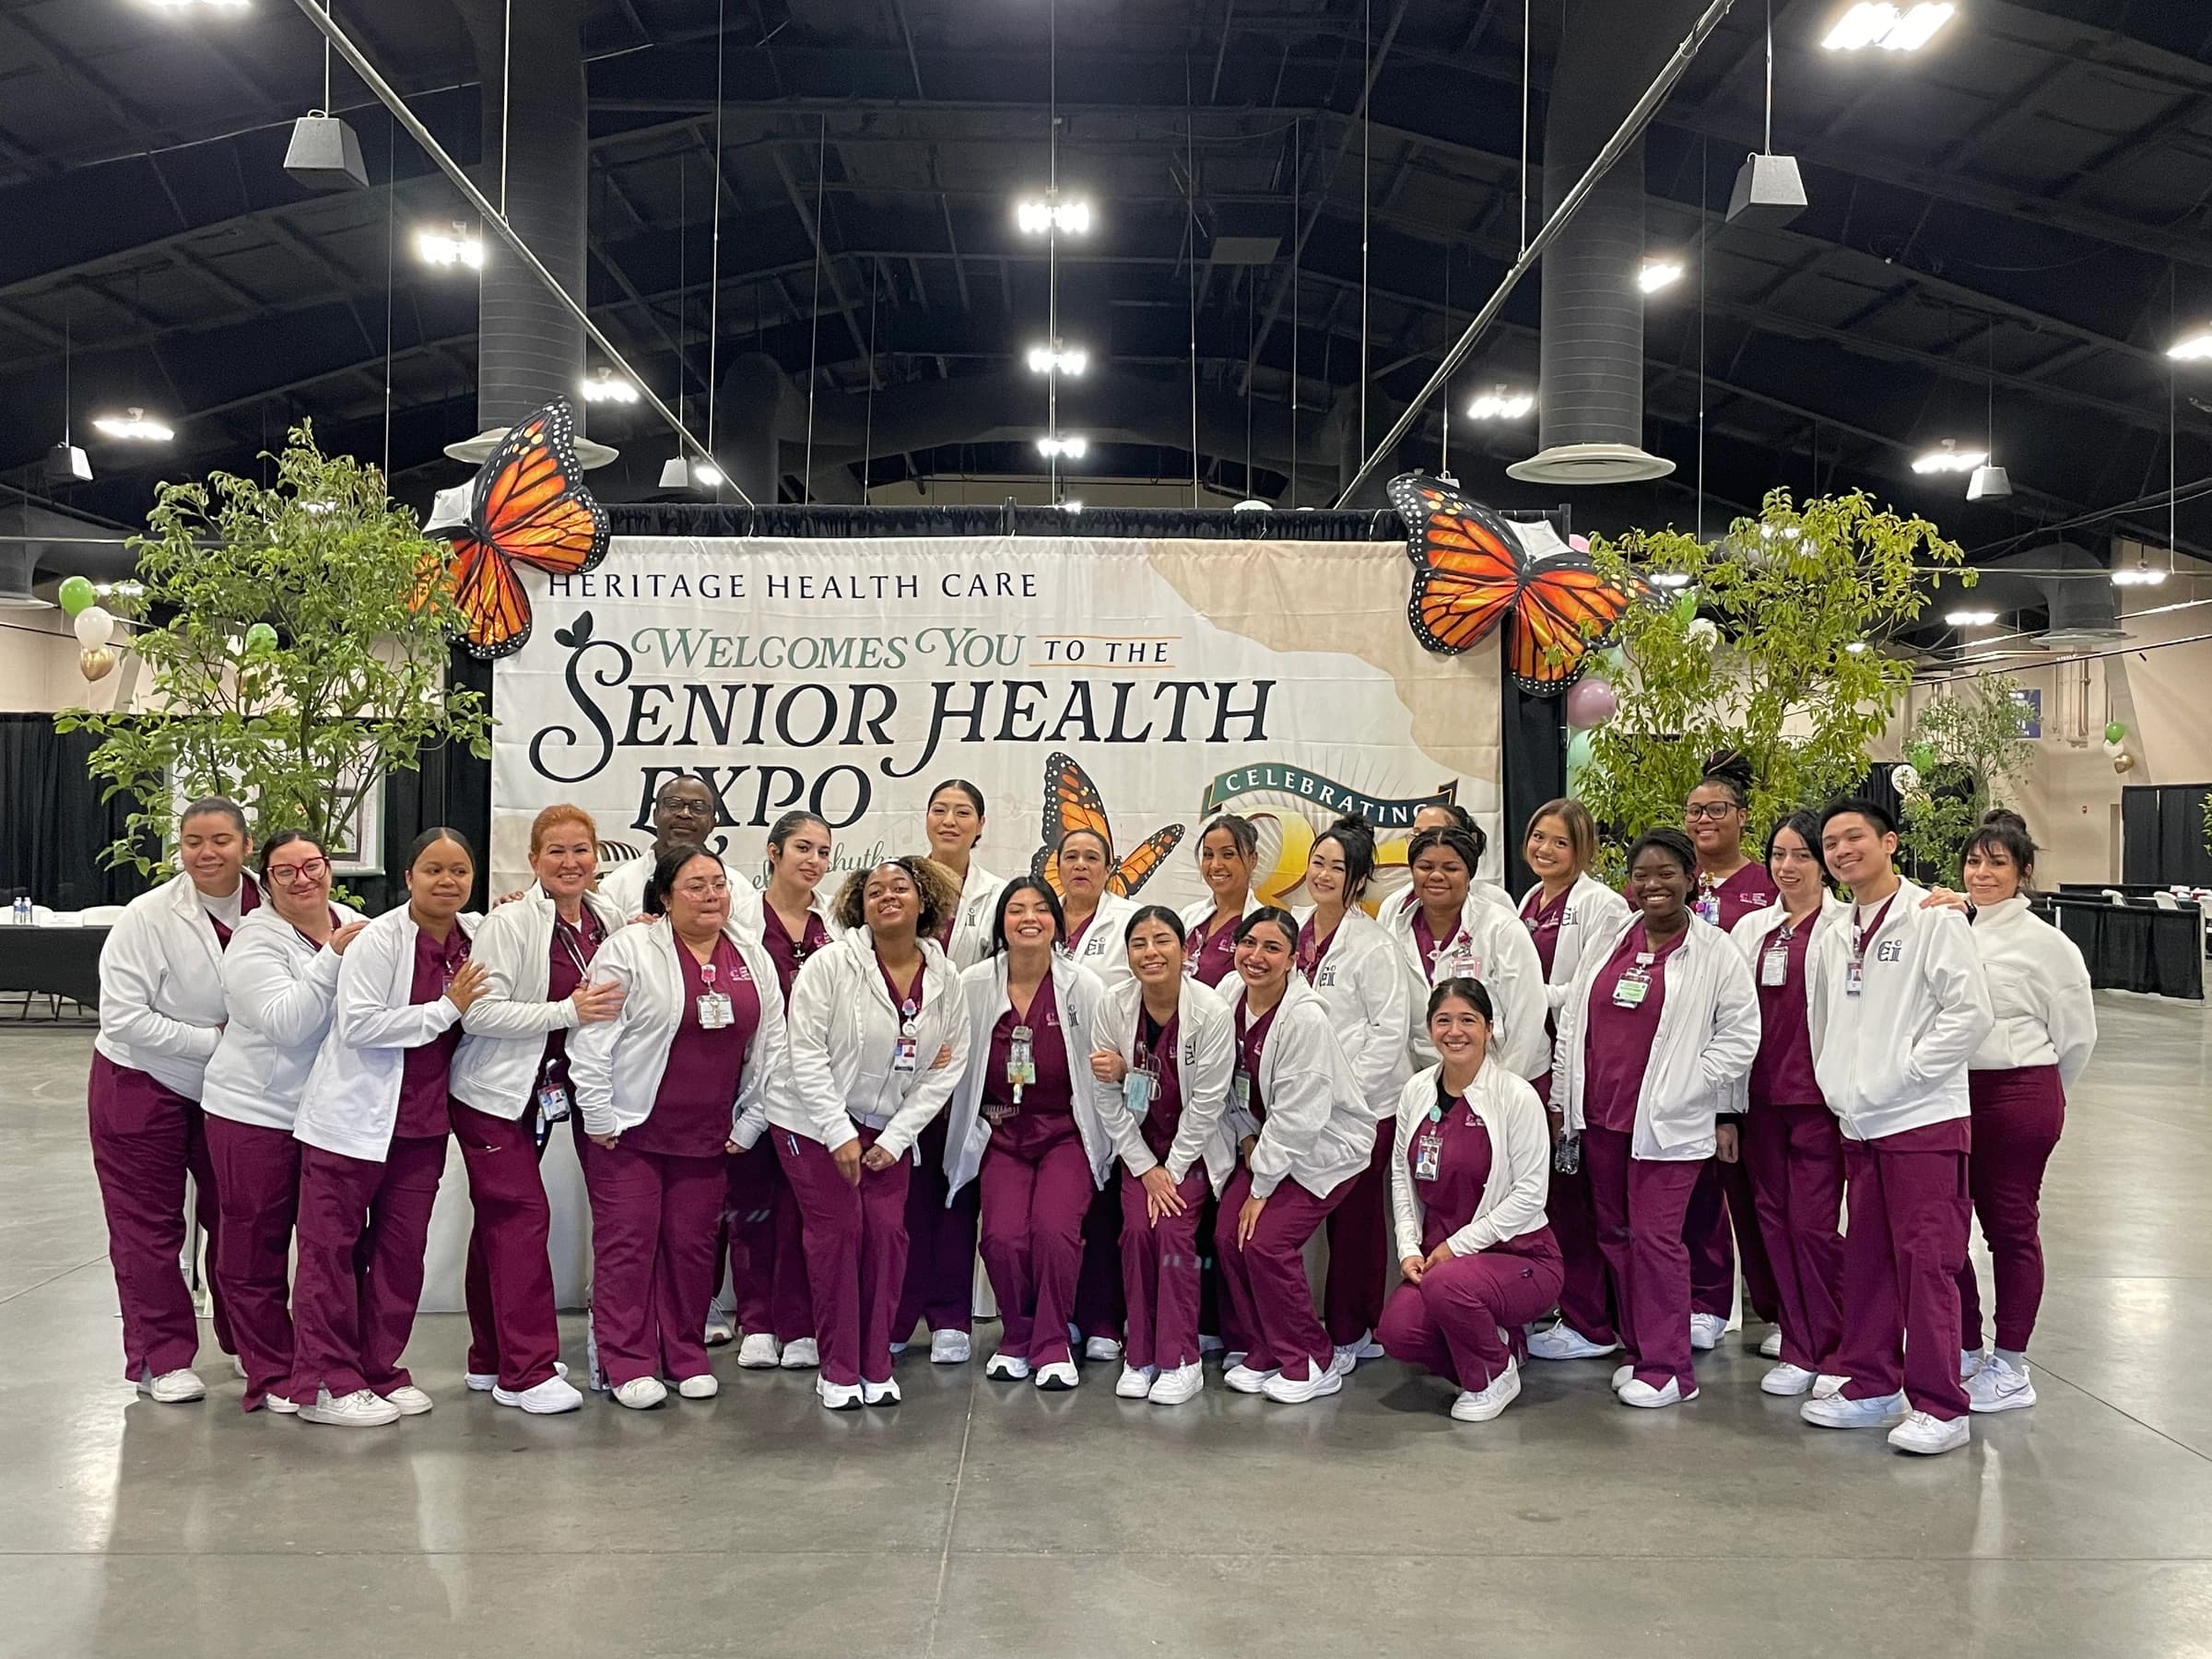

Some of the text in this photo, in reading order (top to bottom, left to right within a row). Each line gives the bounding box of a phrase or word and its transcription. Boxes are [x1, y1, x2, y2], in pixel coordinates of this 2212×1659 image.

[547, 572, 1037, 599] HERITAGE HEALTH CARE
[630, 627, 1169, 670] WELCOMES YOU TO THE
[528, 639, 1277, 783] SENIOR HEALTH
